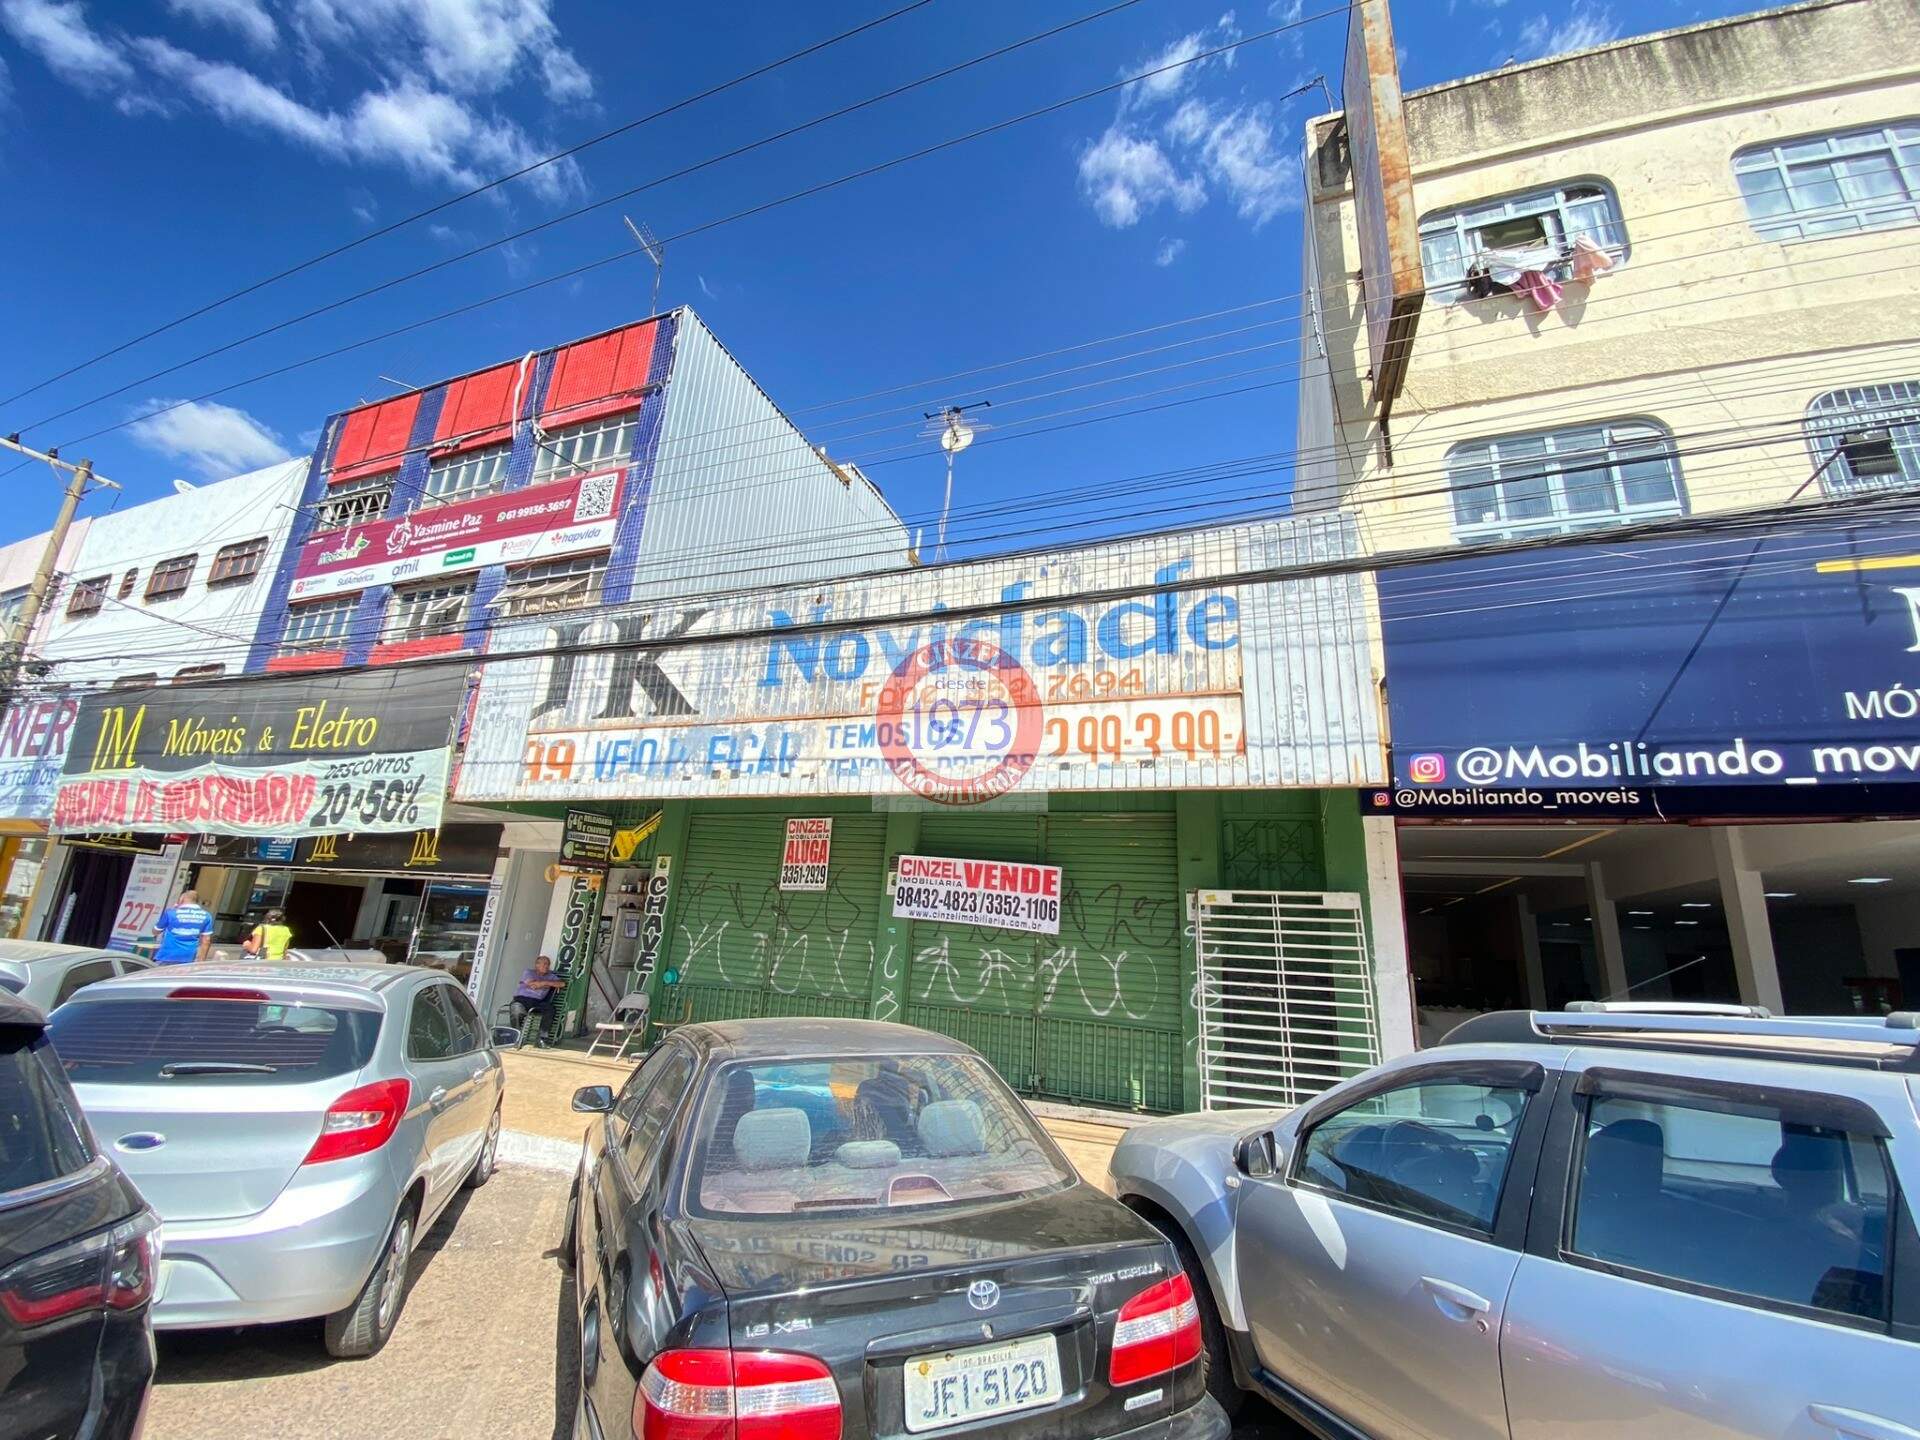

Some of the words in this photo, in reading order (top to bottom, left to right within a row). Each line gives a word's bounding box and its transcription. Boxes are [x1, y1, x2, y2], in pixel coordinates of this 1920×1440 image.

[413, 518, 460, 538] Yasmine
[461, 513, 484, 528] Paz
[561, 527, 602, 544] hapvida
[392, 558, 420, 578] amil
[757, 558, 1240, 687] Novidade
[162, 716, 246, 758] Móveis
[257, 726, 275, 751] &
[289, 699, 379, 749] Eletro
[826, 722, 912, 749] TEMOS
[324, 756, 414, 780] DESCONTOS
[1395, 786, 1640, 809] @Mobiliando_moveis
[788, 820, 830, 834] CINZEL
[785, 840, 828, 864] ALUGA
[782, 865, 827, 884] 3351-2929
[900, 858, 963, 880] CINZEL
[963, 862, 1058, 897] VENDE
[117, 901, 155, 932] 227
[909, 908, 1043, 931] www.cinzelimobiliaria.com.br
